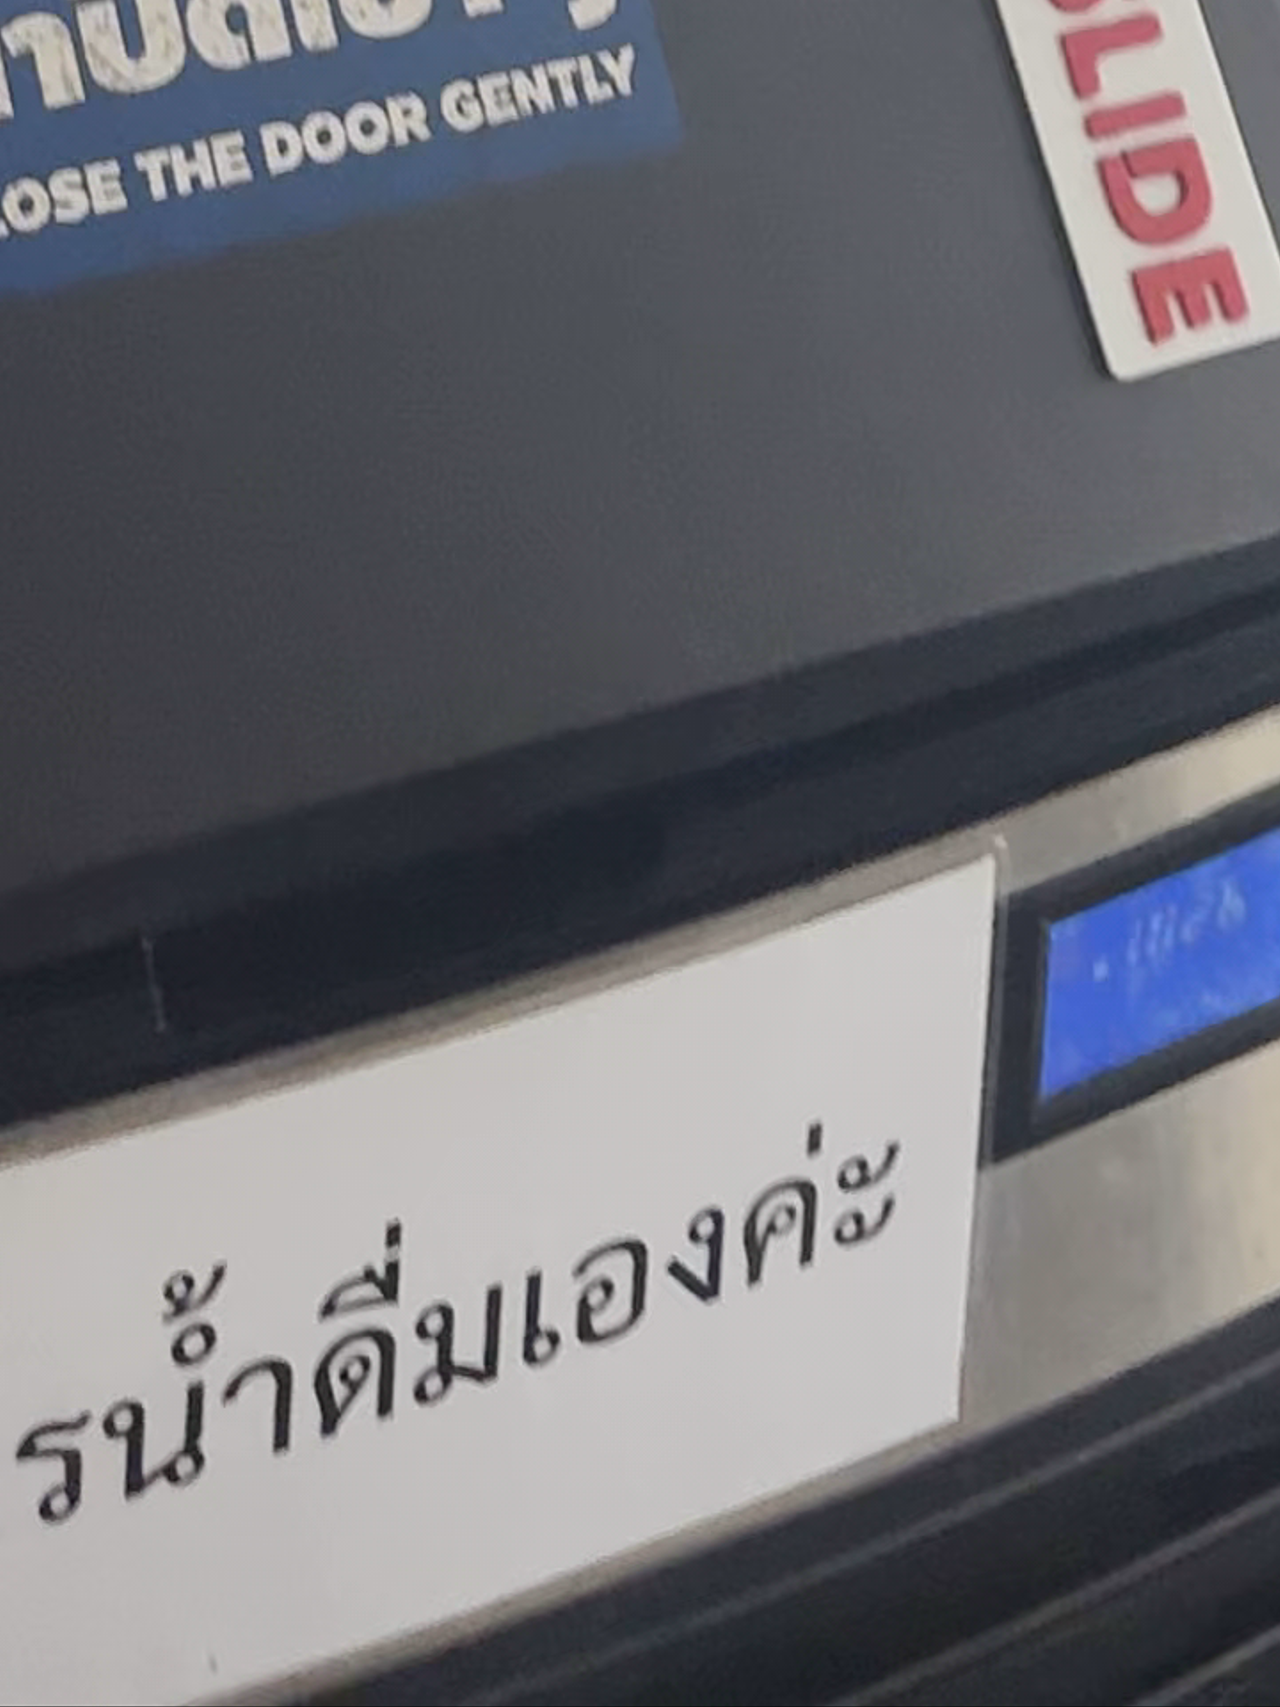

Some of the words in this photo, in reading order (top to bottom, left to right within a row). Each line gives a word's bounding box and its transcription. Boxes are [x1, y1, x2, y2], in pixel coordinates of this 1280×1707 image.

[136, 130, 254, 206] THE
[262, 92, 432, 177] DOOR
[439, 43, 638, 135] GENTLY
